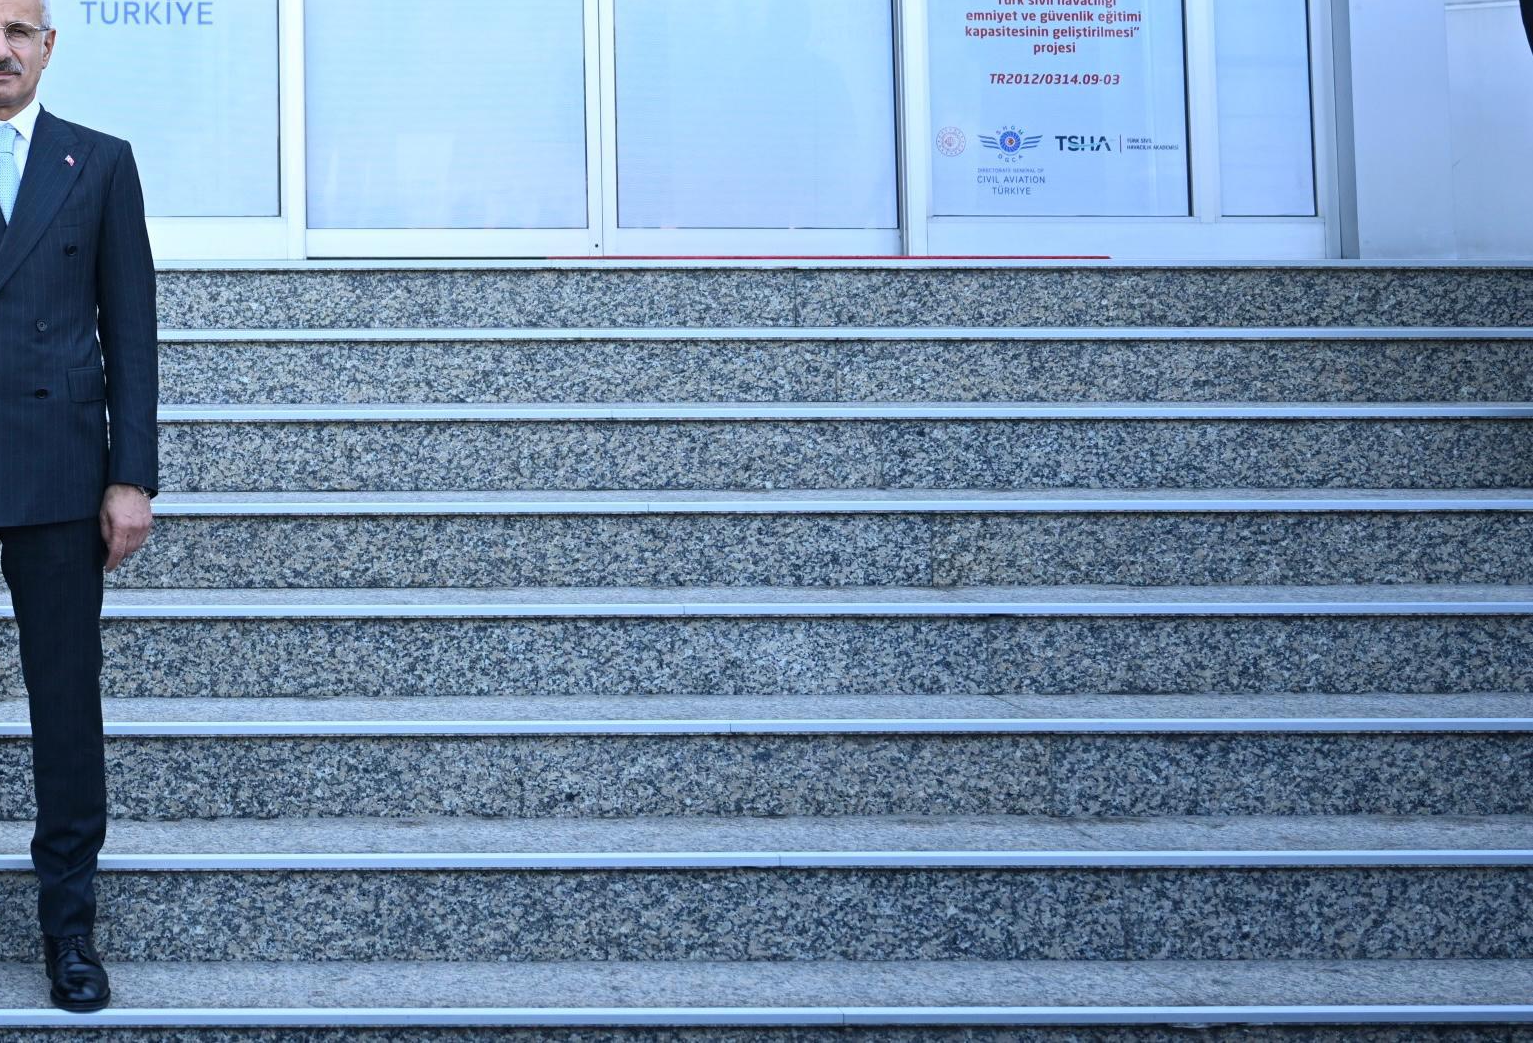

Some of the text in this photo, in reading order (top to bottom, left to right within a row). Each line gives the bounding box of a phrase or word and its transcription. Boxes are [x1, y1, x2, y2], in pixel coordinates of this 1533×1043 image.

[966, 10, 1142, 24] emniyet ve güvenlik eğitimi
[965, 26, 1049, 39] kapasitesinin
[1033, 42, 1076, 55] projesi
[989, 73, 1120, 85] TR2012/0314.09-03
[1055, 135, 1111, 151] TSHA
[977, 176, 1046, 184] CIVIL AVIATION
